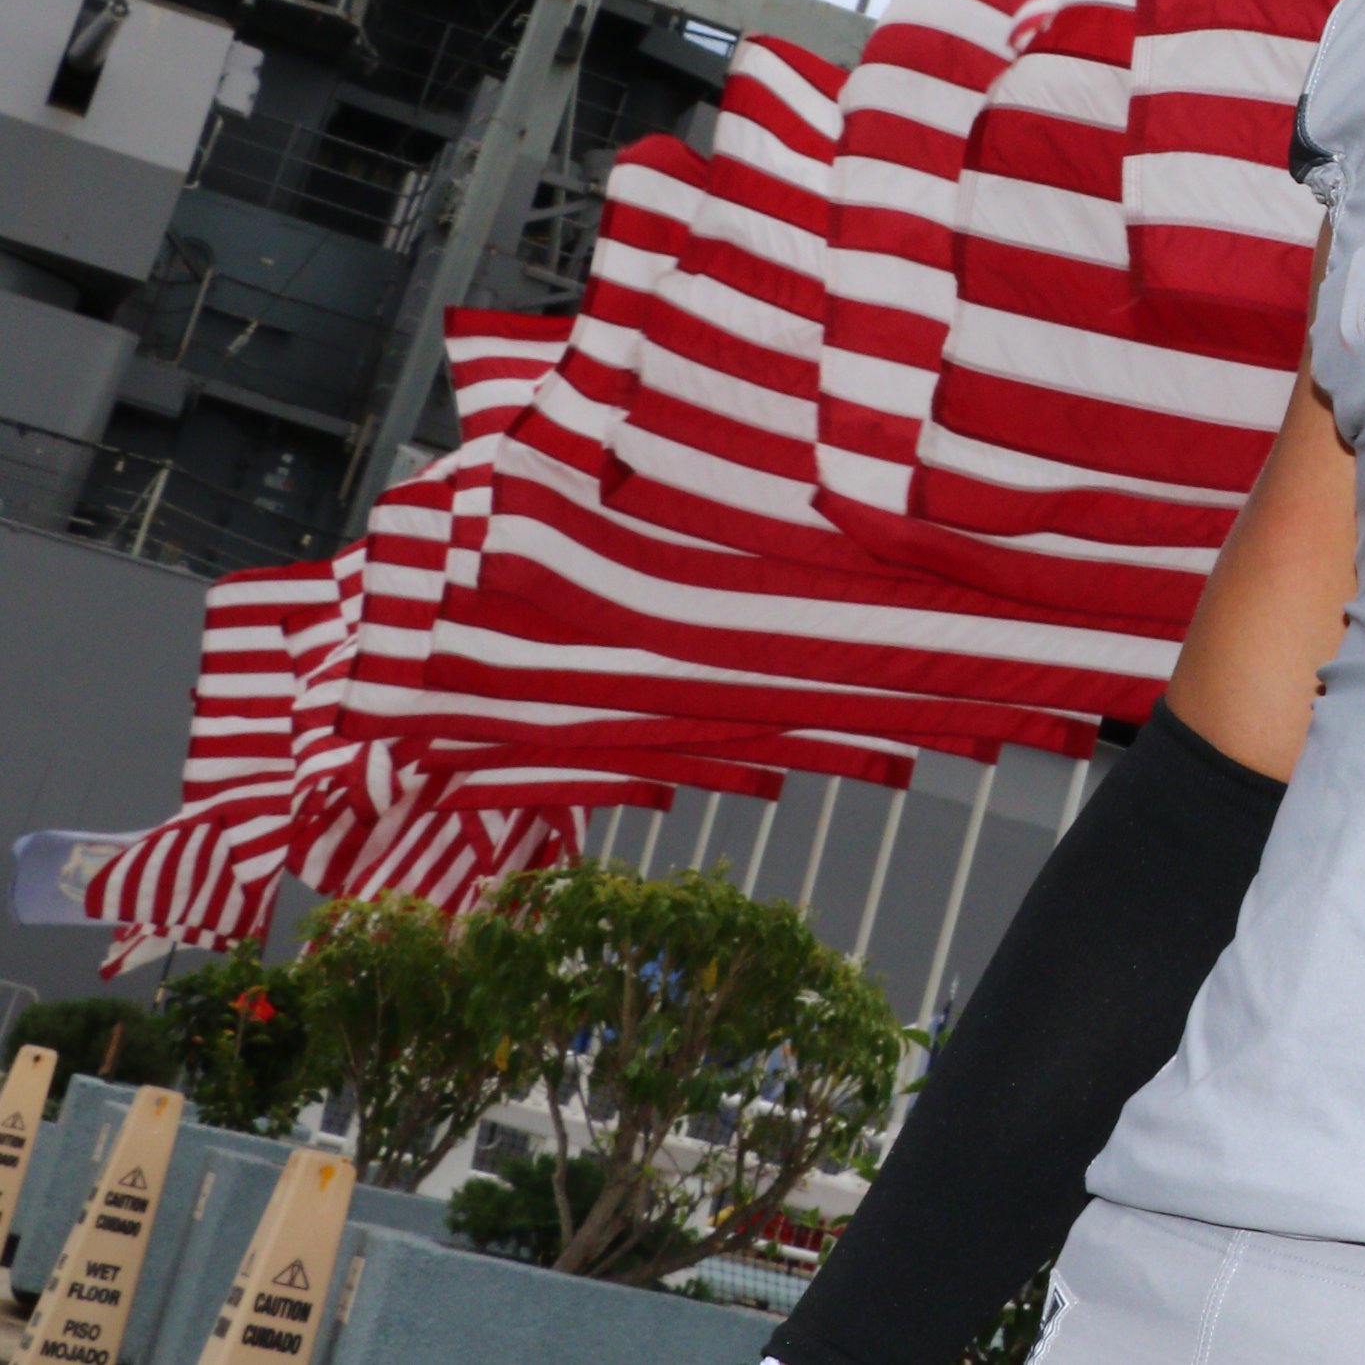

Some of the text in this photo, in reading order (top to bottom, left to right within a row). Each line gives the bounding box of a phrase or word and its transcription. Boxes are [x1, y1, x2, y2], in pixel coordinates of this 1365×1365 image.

[104, 1190, 149, 1213] CAUTION
[86, 1260, 121, 1282] WET
[67, 1281, 121, 1306] FLOOR
[254, 1292, 312, 1323] CAUTION
[63, 1318, 102, 1341] PISO
[242, 1324, 302, 1355] CUIDADO
[40, 1339, 109, 1365] MOJADO
